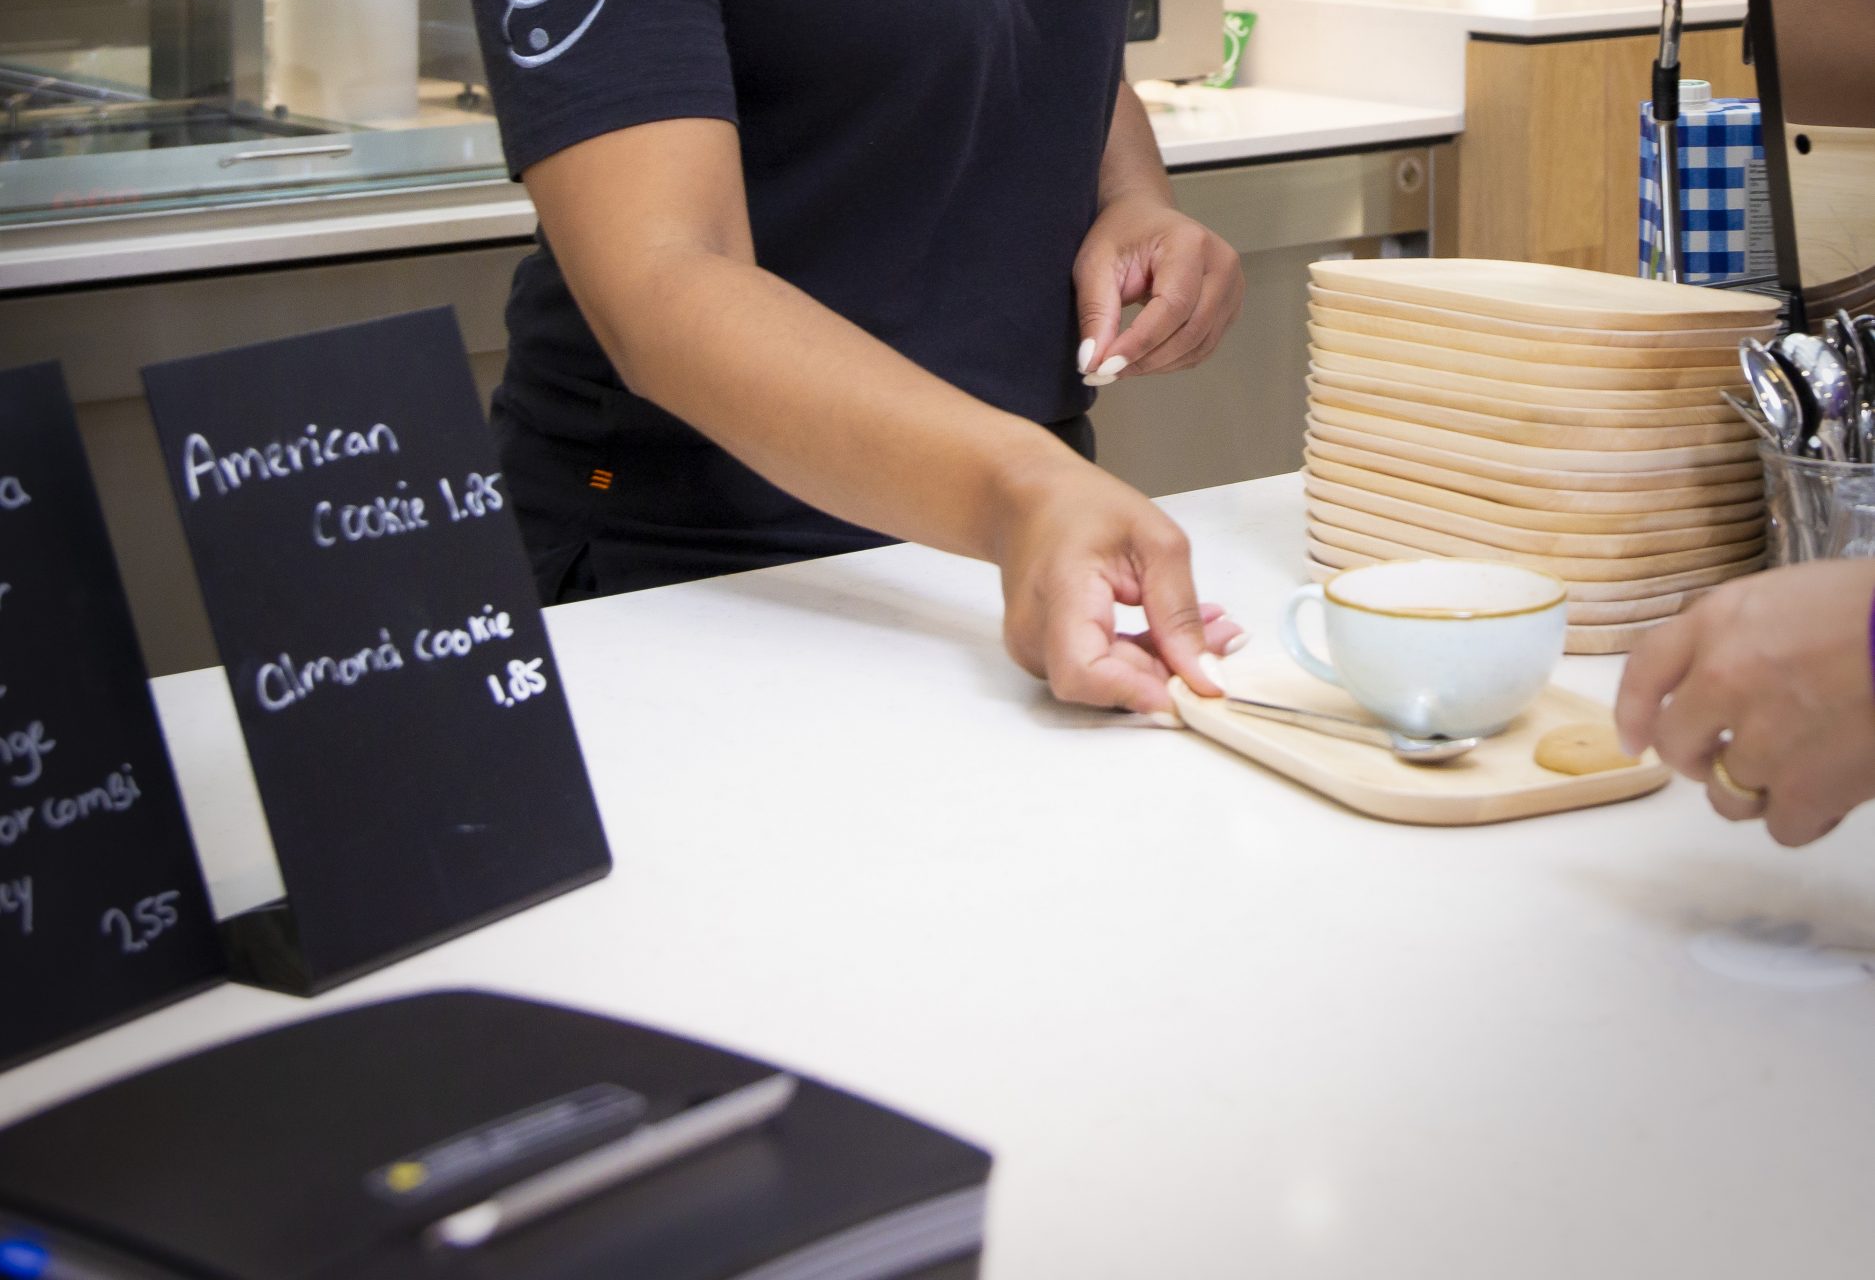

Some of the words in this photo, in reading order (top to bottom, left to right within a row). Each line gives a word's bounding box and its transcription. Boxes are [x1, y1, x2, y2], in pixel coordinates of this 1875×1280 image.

[184, 423, 399, 502] American
[438, 472, 503, 521] 1.85
[413, 604, 515, 662] cookie
[486, 656, 548, 709] 1.85
[41, 762, 142, 829] combi
